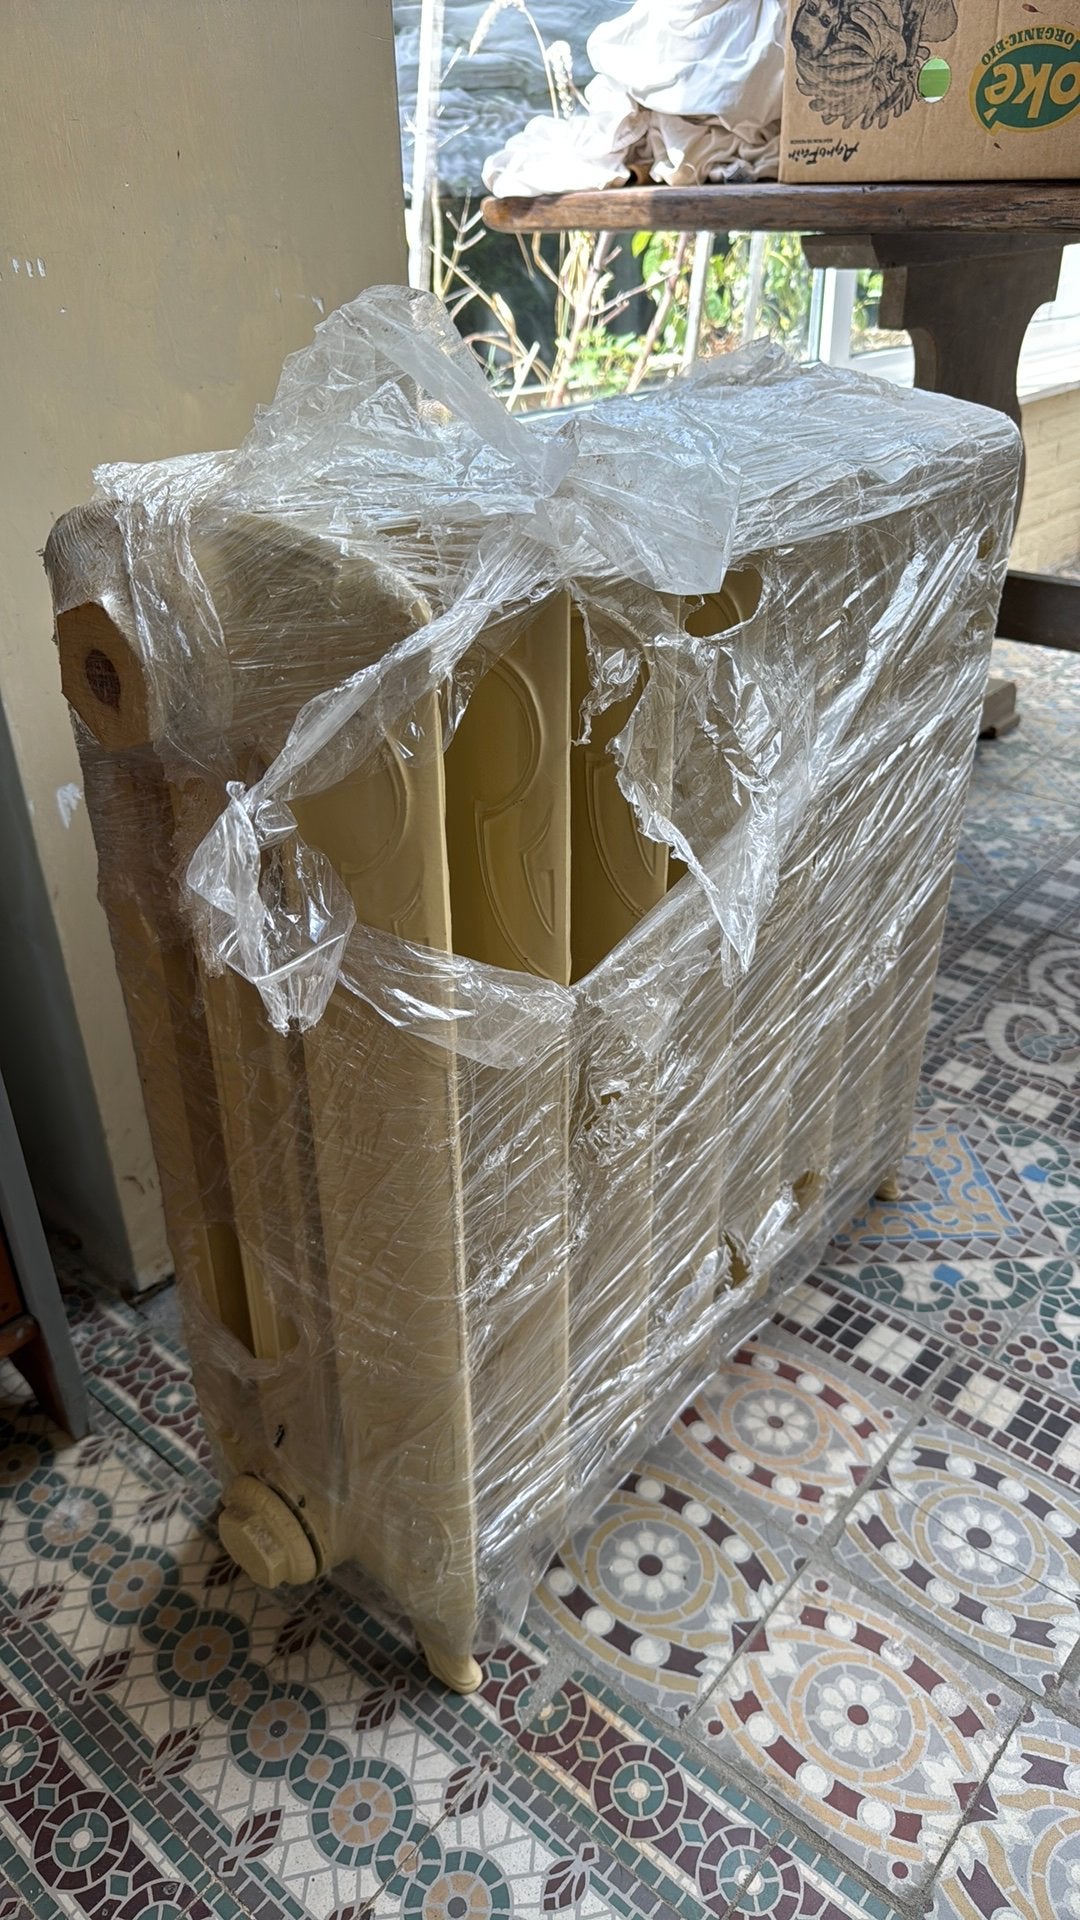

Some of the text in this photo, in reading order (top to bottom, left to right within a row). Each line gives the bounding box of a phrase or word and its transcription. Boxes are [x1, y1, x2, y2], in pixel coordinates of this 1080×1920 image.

[981, 27, 1074, 66] ORGANIC-BIO
[983, 61, 1080, 121] oké
[788, 138, 860, 165] AgroFair
